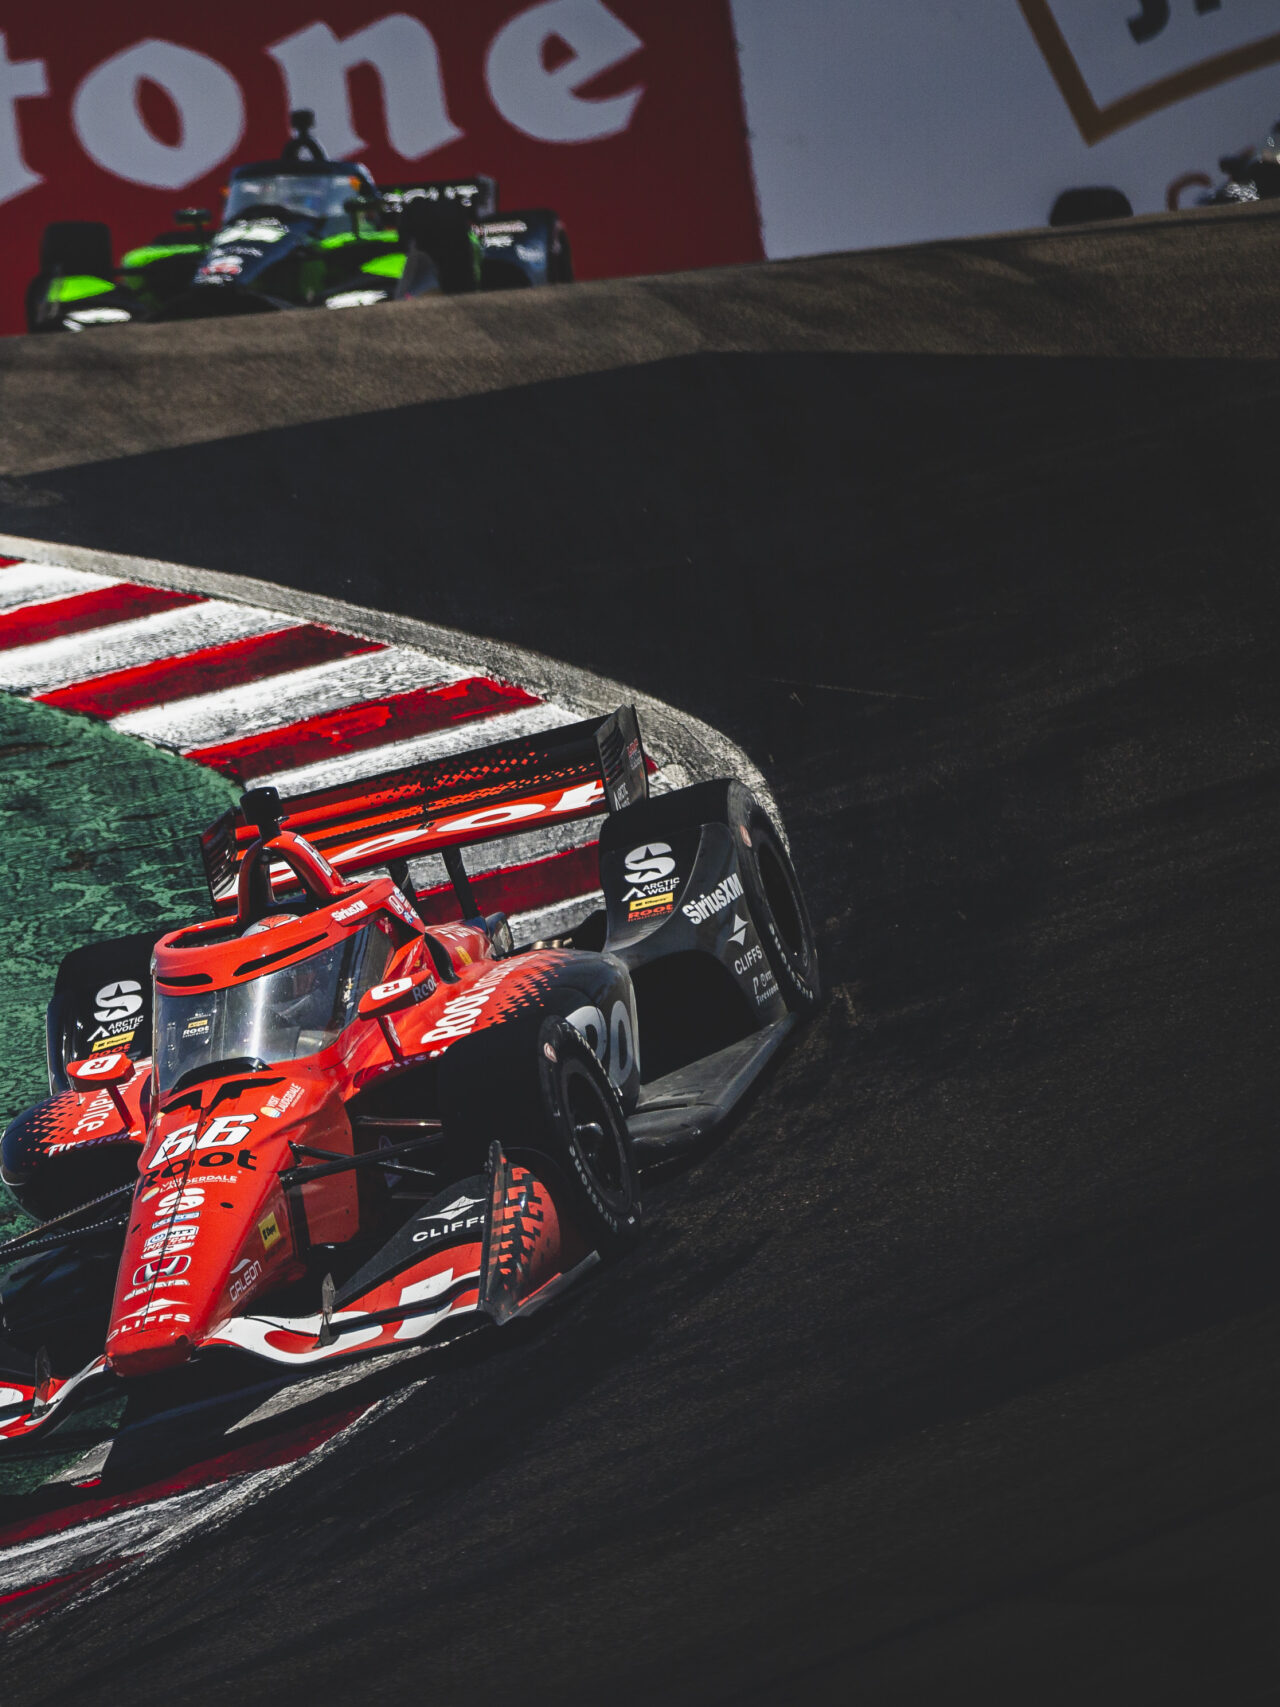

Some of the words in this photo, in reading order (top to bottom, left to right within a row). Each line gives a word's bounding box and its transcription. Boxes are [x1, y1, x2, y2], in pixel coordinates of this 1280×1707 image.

[642, 877, 681, 892] ARCTIC
[647, 884, 677, 896] WOLF
[682, 872, 745, 925] SiriusXM
[331, 899, 369, 922] SiriusXM
[734, 945, 763, 975] CLIFFS
[107, 1015, 145, 1031] ARCTIC
[112, 1022, 141, 1035] WOLF
[266, 1095, 281, 1108] VISIT
[276, 1083, 302, 1113] LAUDERDALE
[148, 1113, 259, 1170] 66
[168, 1227, 195, 1237] NTT
[142, 1234, 197, 1253] INDCAR
[229, 1260, 262, 1302] GALEON
[106, 1313, 192, 1343] CLIFFS
